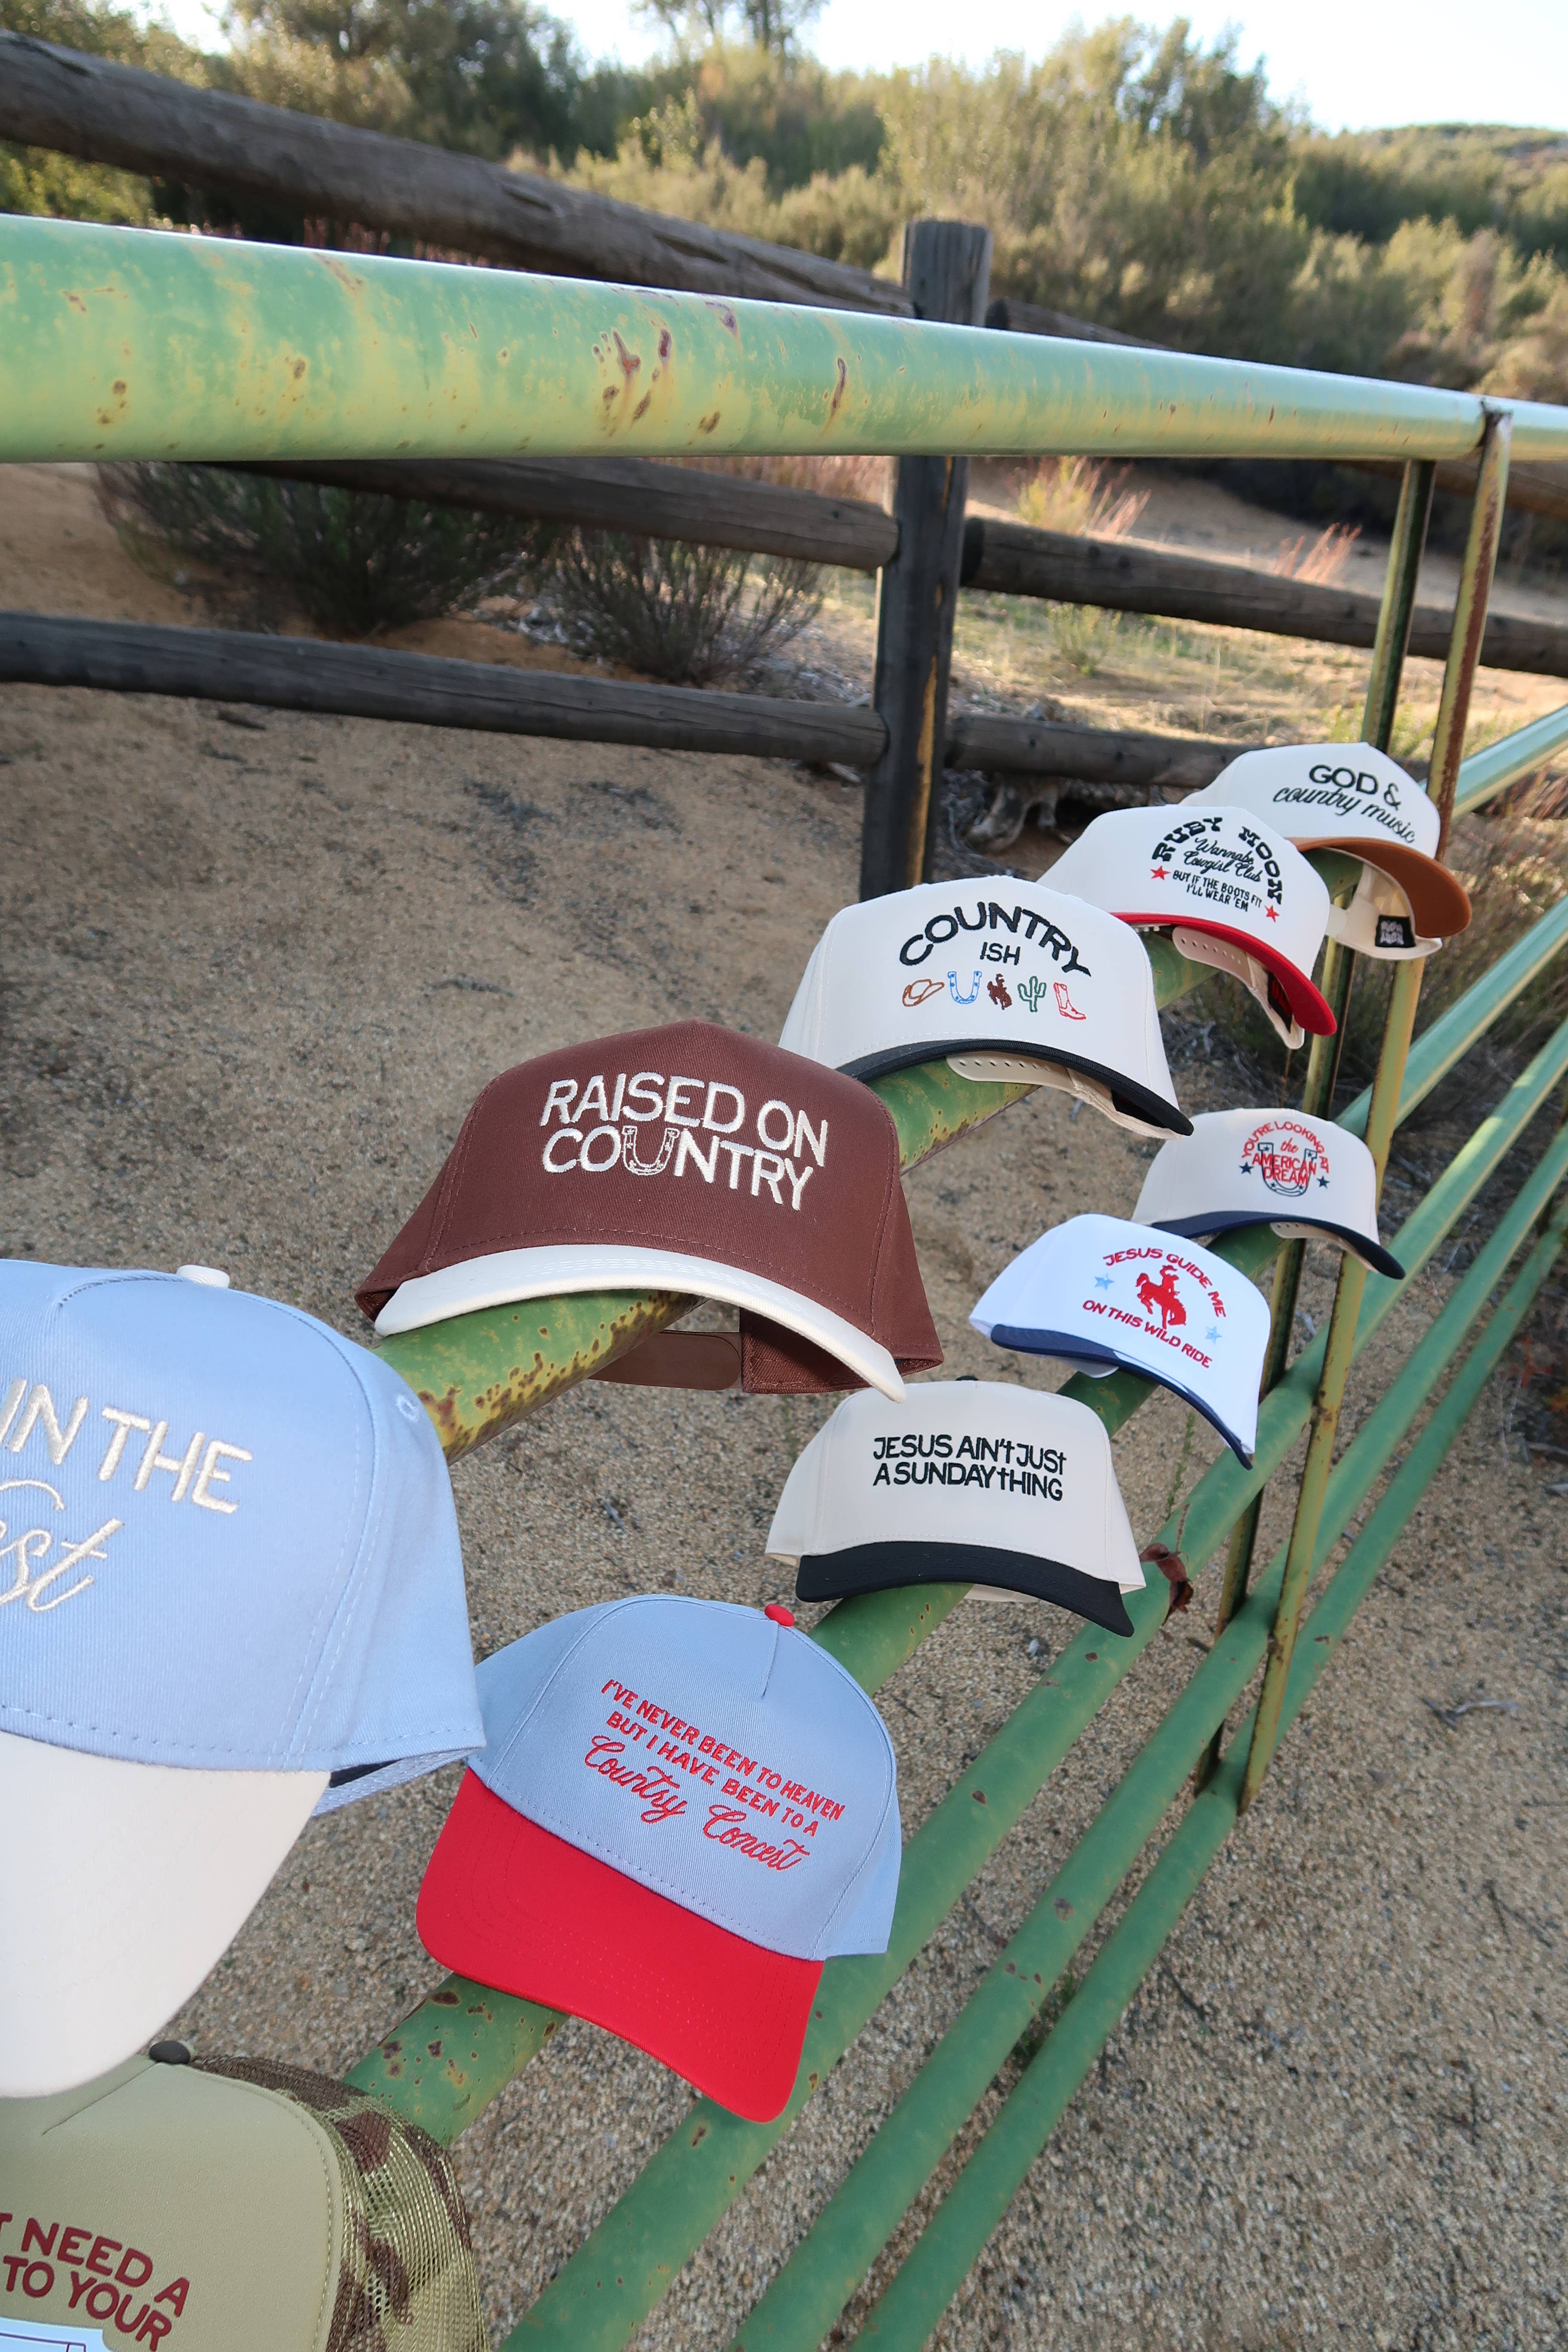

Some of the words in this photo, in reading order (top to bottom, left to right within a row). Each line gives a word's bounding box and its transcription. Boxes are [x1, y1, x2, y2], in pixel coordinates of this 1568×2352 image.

[1273, 787, 1362, 818] country
[1361, 803, 1415, 843] music
[1309, 764, 1378, 795] GOD
[1384, 782, 1401, 811] &
[1152, 817, 1222, 862] RUBY
[1238, 826, 1283, 905] MOON
[1184, 851, 1234, 874] Cowgirl
[1235, 862, 1263, 882] Club
[1195, 837, 1254, 866] Wannabe
[1186, 883, 1203, 896] I'LL
[1205, 888, 1231, 904] WEAR
[1191, 875, 1201, 884] IF
[1203, 877, 1219, 890] THE
[1221, 882, 1250, 900] BOOTS
[1251, 895, 1262, 908] FIT
[900, 901, 1091, 977] COUNTRY
[539, 1072, 745, 1133] RAISED
[756, 1099, 828, 1167] ON
[1274, 1121, 1325, 1155] LOOKING
[1280, 1137, 1299, 1153] the
[542, 1125, 814, 1212] COUNTRY
[1252, 1153, 1317, 1175] AMERICAN
[1263, 1167, 1309, 1187] DREAM
[1103, 1247, 1163, 1266] JESUS
[1166, 1253, 1213, 1289] GUIDE
[1207, 1291, 1226, 1318] ME
[1083, 1300, 1108, 1314] ON
[1109, 1307, 1143, 1328] THIS
[1145, 1321, 1181, 1348] WILD
[1181, 1343, 1213, 1368] RIDE
[98, 1406, 253, 1514] THE
[873, 1434, 952, 1460] JESUS
[873, 1463, 891, 1486] A
[894, 1462, 996, 1488] SUNDAY
[601, 1679, 638, 1710] I'VE
[636, 1700, 700, 1746] NEVER
[698, 1735, 758, 1776] BEEN
[756, 1767, 781, 1789] TO
[780, 1780, 846, 1821] HEAVEN
[606, 1711, 648, 1742] BUT
[646, 1735, 659, 1750] I
[657, 1741, 720, 1785] HAVE
[721, 1778, 781, 1817] BEEN
[781, 1807, 803, 1828] TO
[803, 1820, 819, 1838] A
[584, 1735, 687, 1824] Country
[702, 1804, 810, 1871] Concert
[21, 2218, 153, 2288] NEED
[153, 2276, 190, 2318] A
[3, 2255, 55, 2298] TO
[68, 2270, 172, 2352] YOUR
